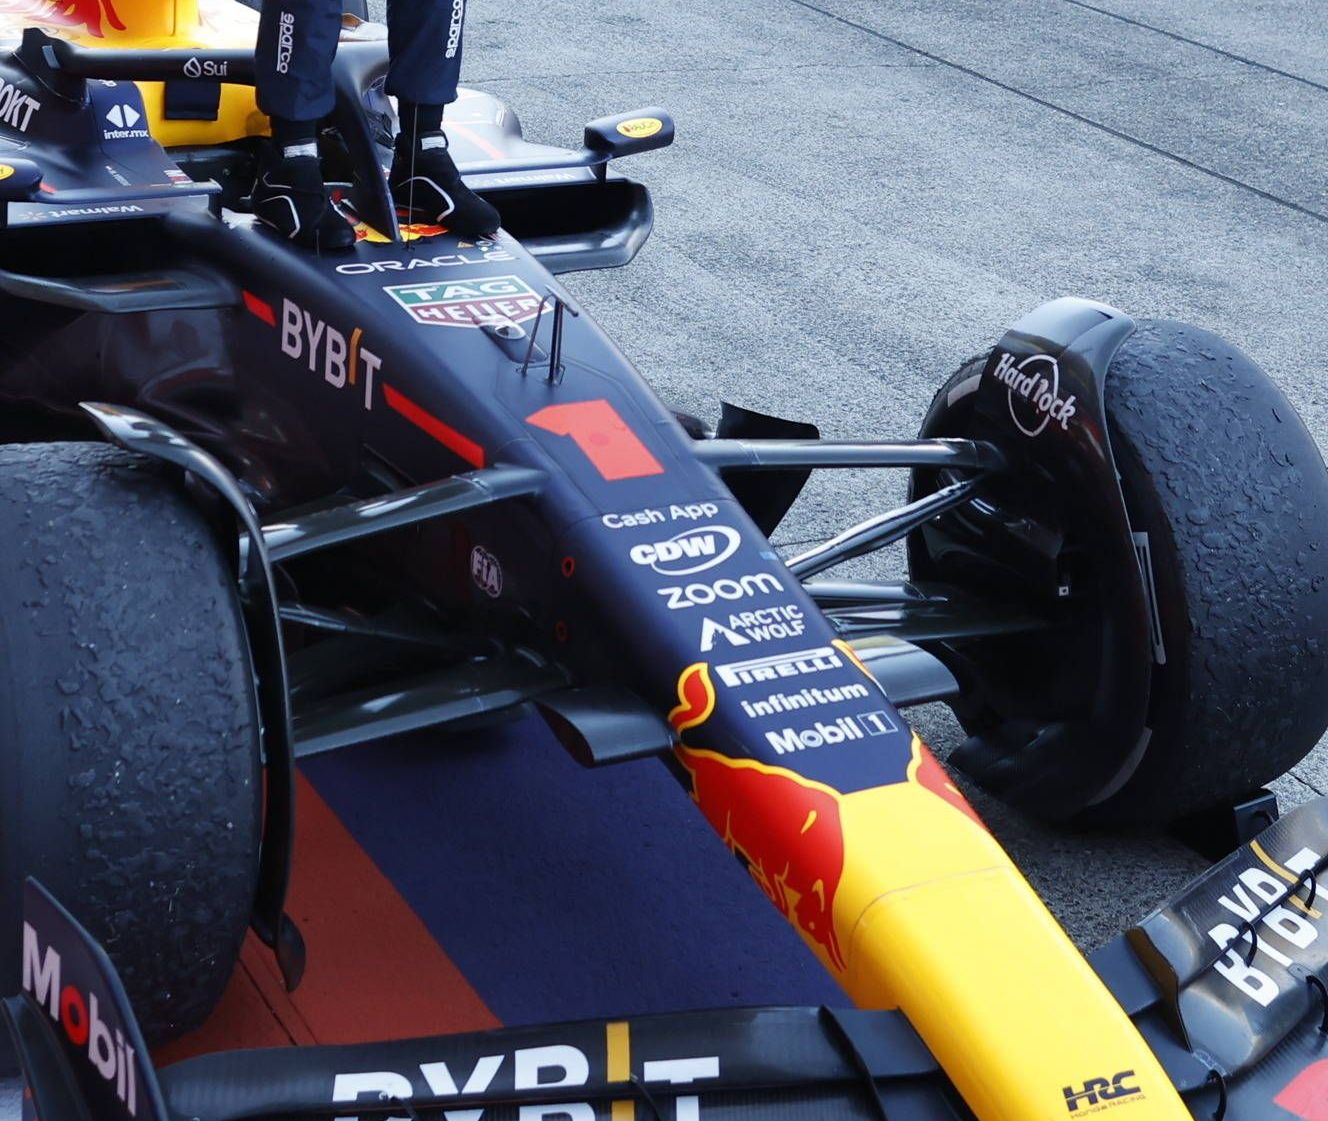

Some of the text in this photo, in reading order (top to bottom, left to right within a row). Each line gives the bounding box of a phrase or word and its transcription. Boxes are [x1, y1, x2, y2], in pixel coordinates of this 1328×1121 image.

[276, 11, 296, 74] sparco
[203, 61, 228, 77] Sui
[103, 129, 149, 140] inter.mx
[335, 251, 517, 275] ORACLE
[400, 280, 516, 302] TAG
[416, 297, 544, 324] HEUER
[281, 297, 382, 411] BYBIT
[993, 352, 1040, 400] Hard
[524, 398, 666, 482] 1
[602, 500, 719, 530] Cash App
[629, 533, 716, 567] CDW
[657, 572, 784, 610] zoom
[728, 604, 805, 630] ARCTIC
[744, 619, 807, 643] WOLF
[715, 646, 844, 688] PIRELLI
[740, 681, 868, 719] infinitum
[764, 717, 863, 755] Mobil
[23, 920, 136, 1116] Mobil
[1062, 1069, 1142, 1112] HRC
